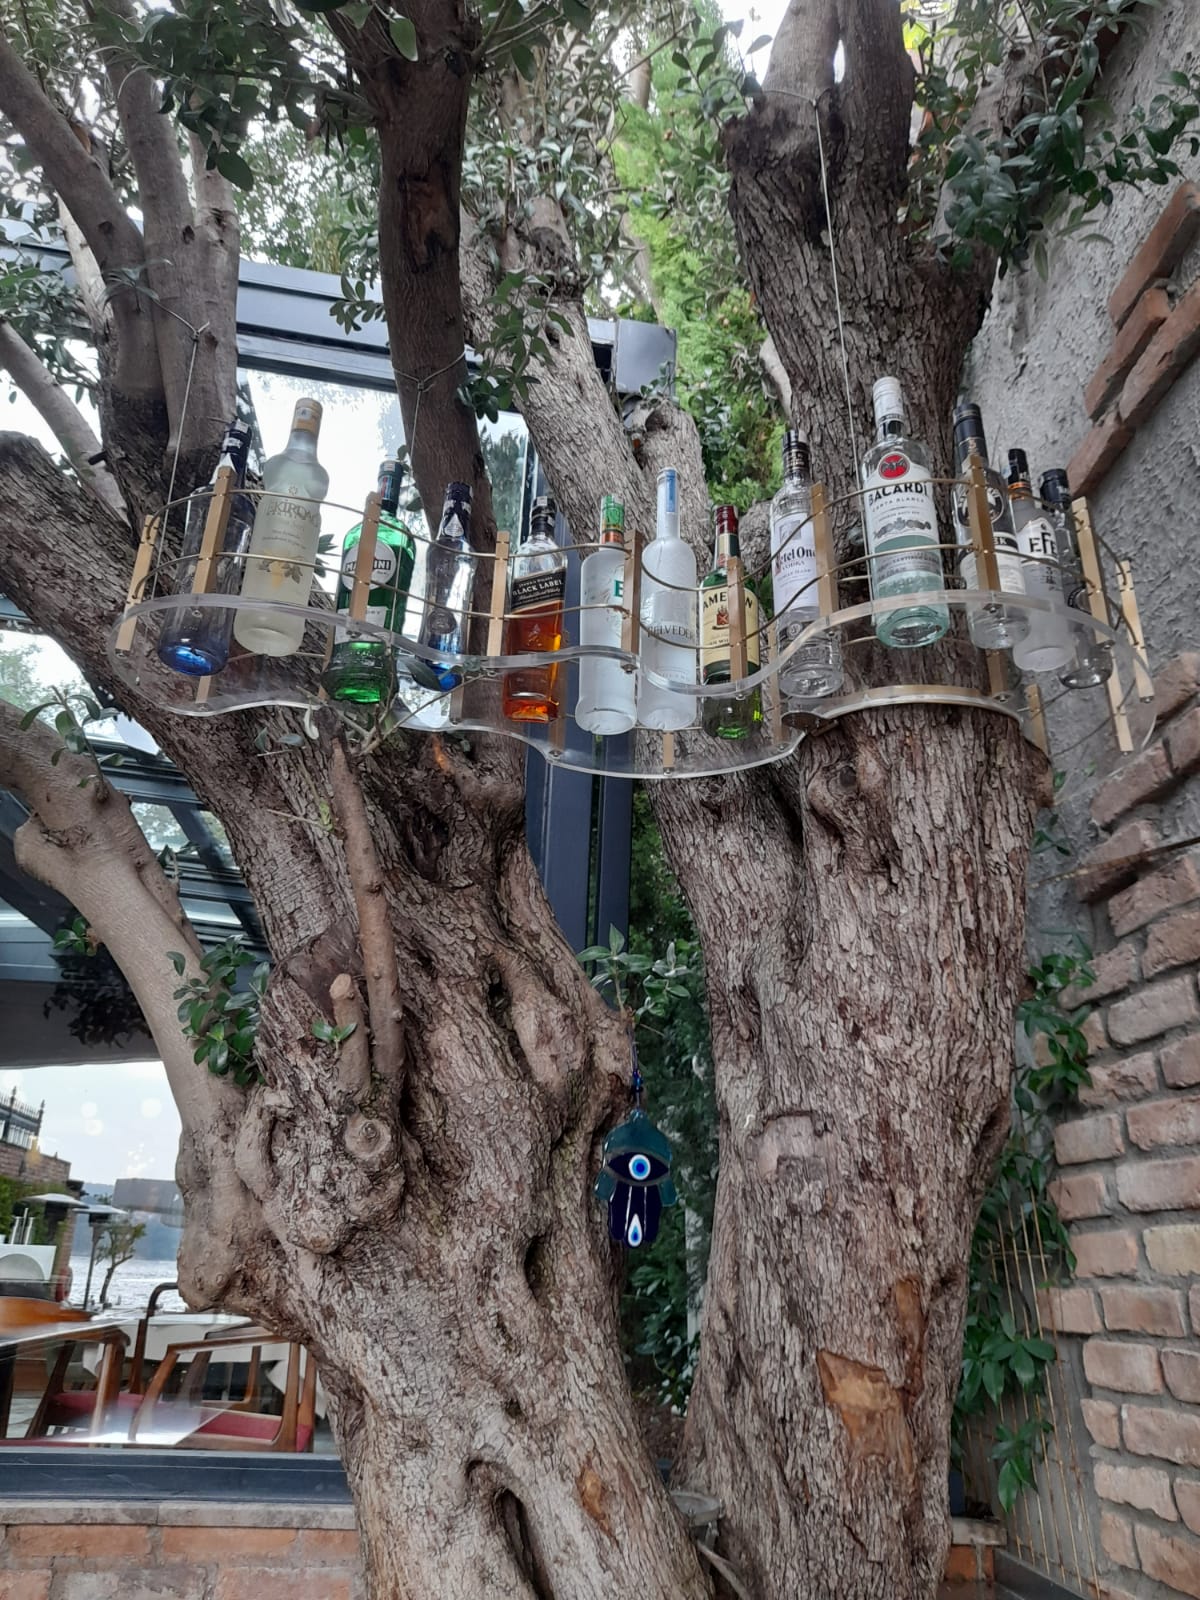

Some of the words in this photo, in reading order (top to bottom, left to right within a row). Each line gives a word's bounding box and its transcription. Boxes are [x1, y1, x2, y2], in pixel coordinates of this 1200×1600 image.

[345, 560, 391, 572] MAINI
[512, 584, 538, 596] BLACK
[539, 579, 563, 590] LABEL
[702, 591, 753, 610] AMEN
